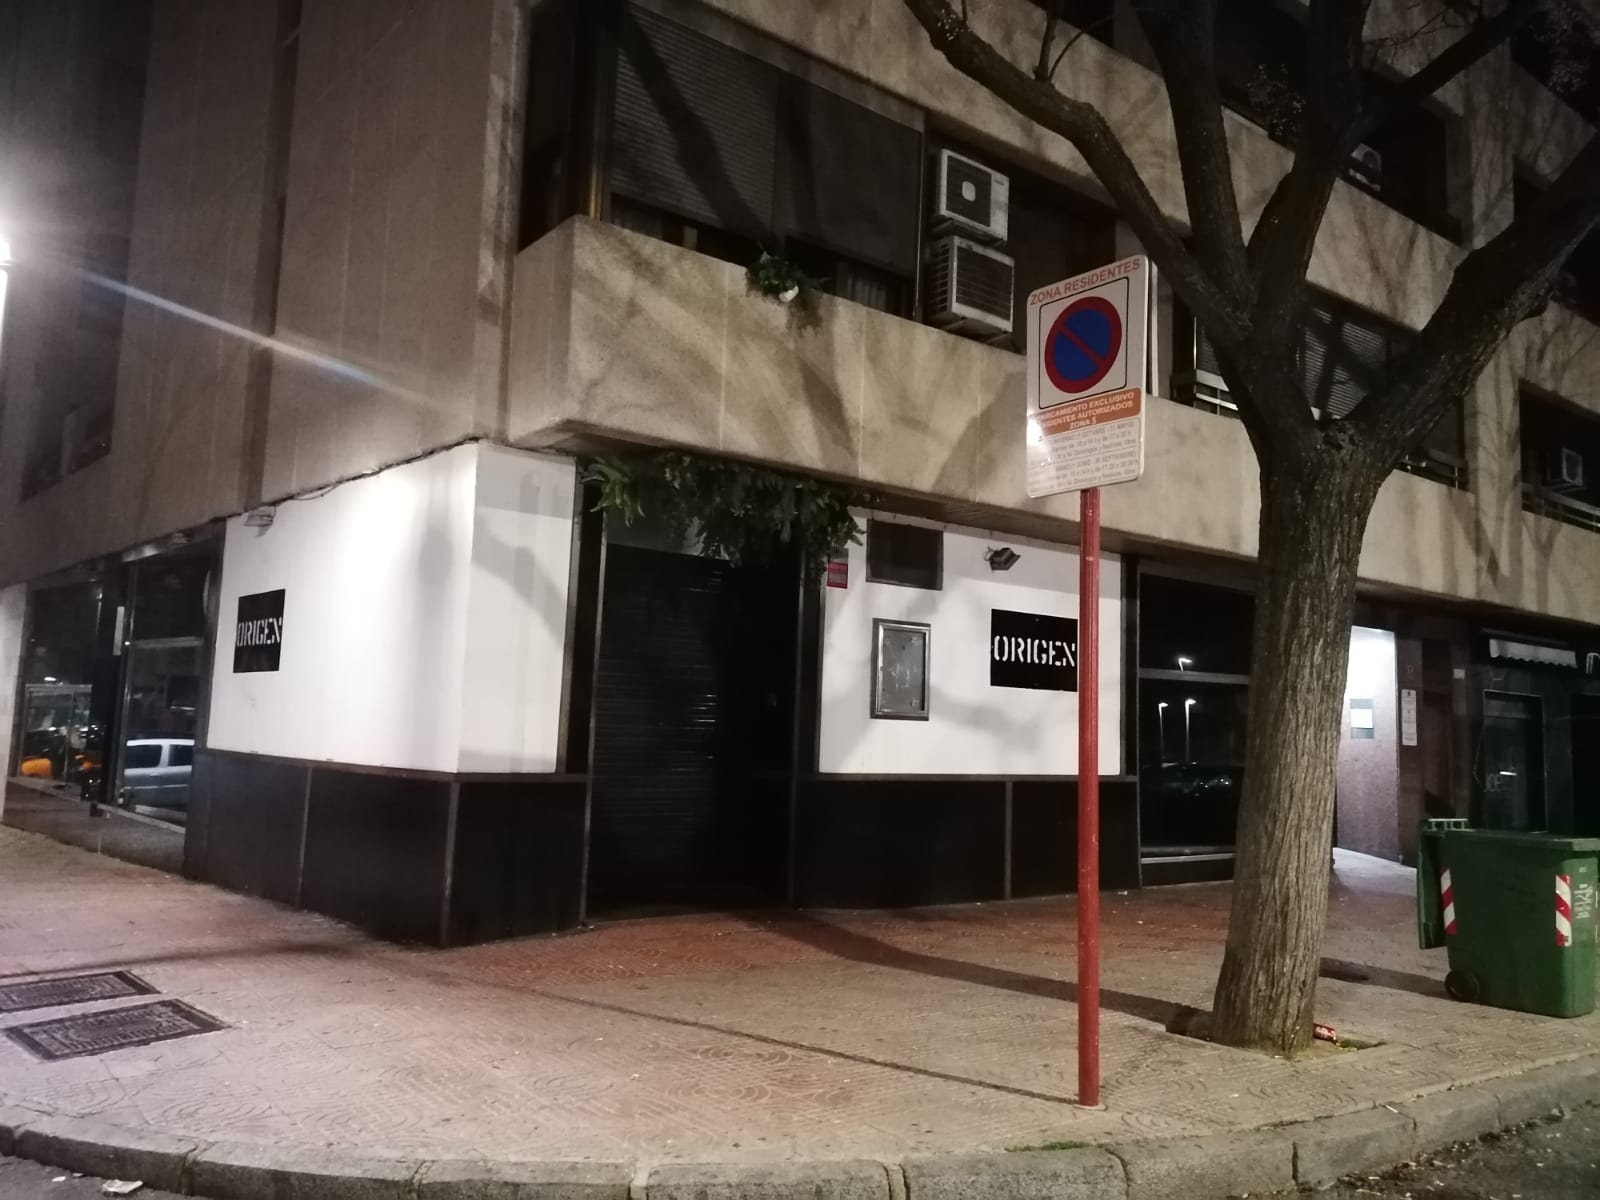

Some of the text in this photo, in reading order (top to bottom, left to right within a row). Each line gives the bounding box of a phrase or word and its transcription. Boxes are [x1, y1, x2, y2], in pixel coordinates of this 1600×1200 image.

[1030, 258, 1141, 305] ZONA RESIDENTES
[1077, 401, 1133, 419] AUTORIZADOS
[1089, 392, 1134, 409] EXCLUSIVO
[1070, 418, 1090, 429] ZONA
[237, 616, 282, 648] ORIGEN
[993, 634, 1076, 667] ORIGEN
